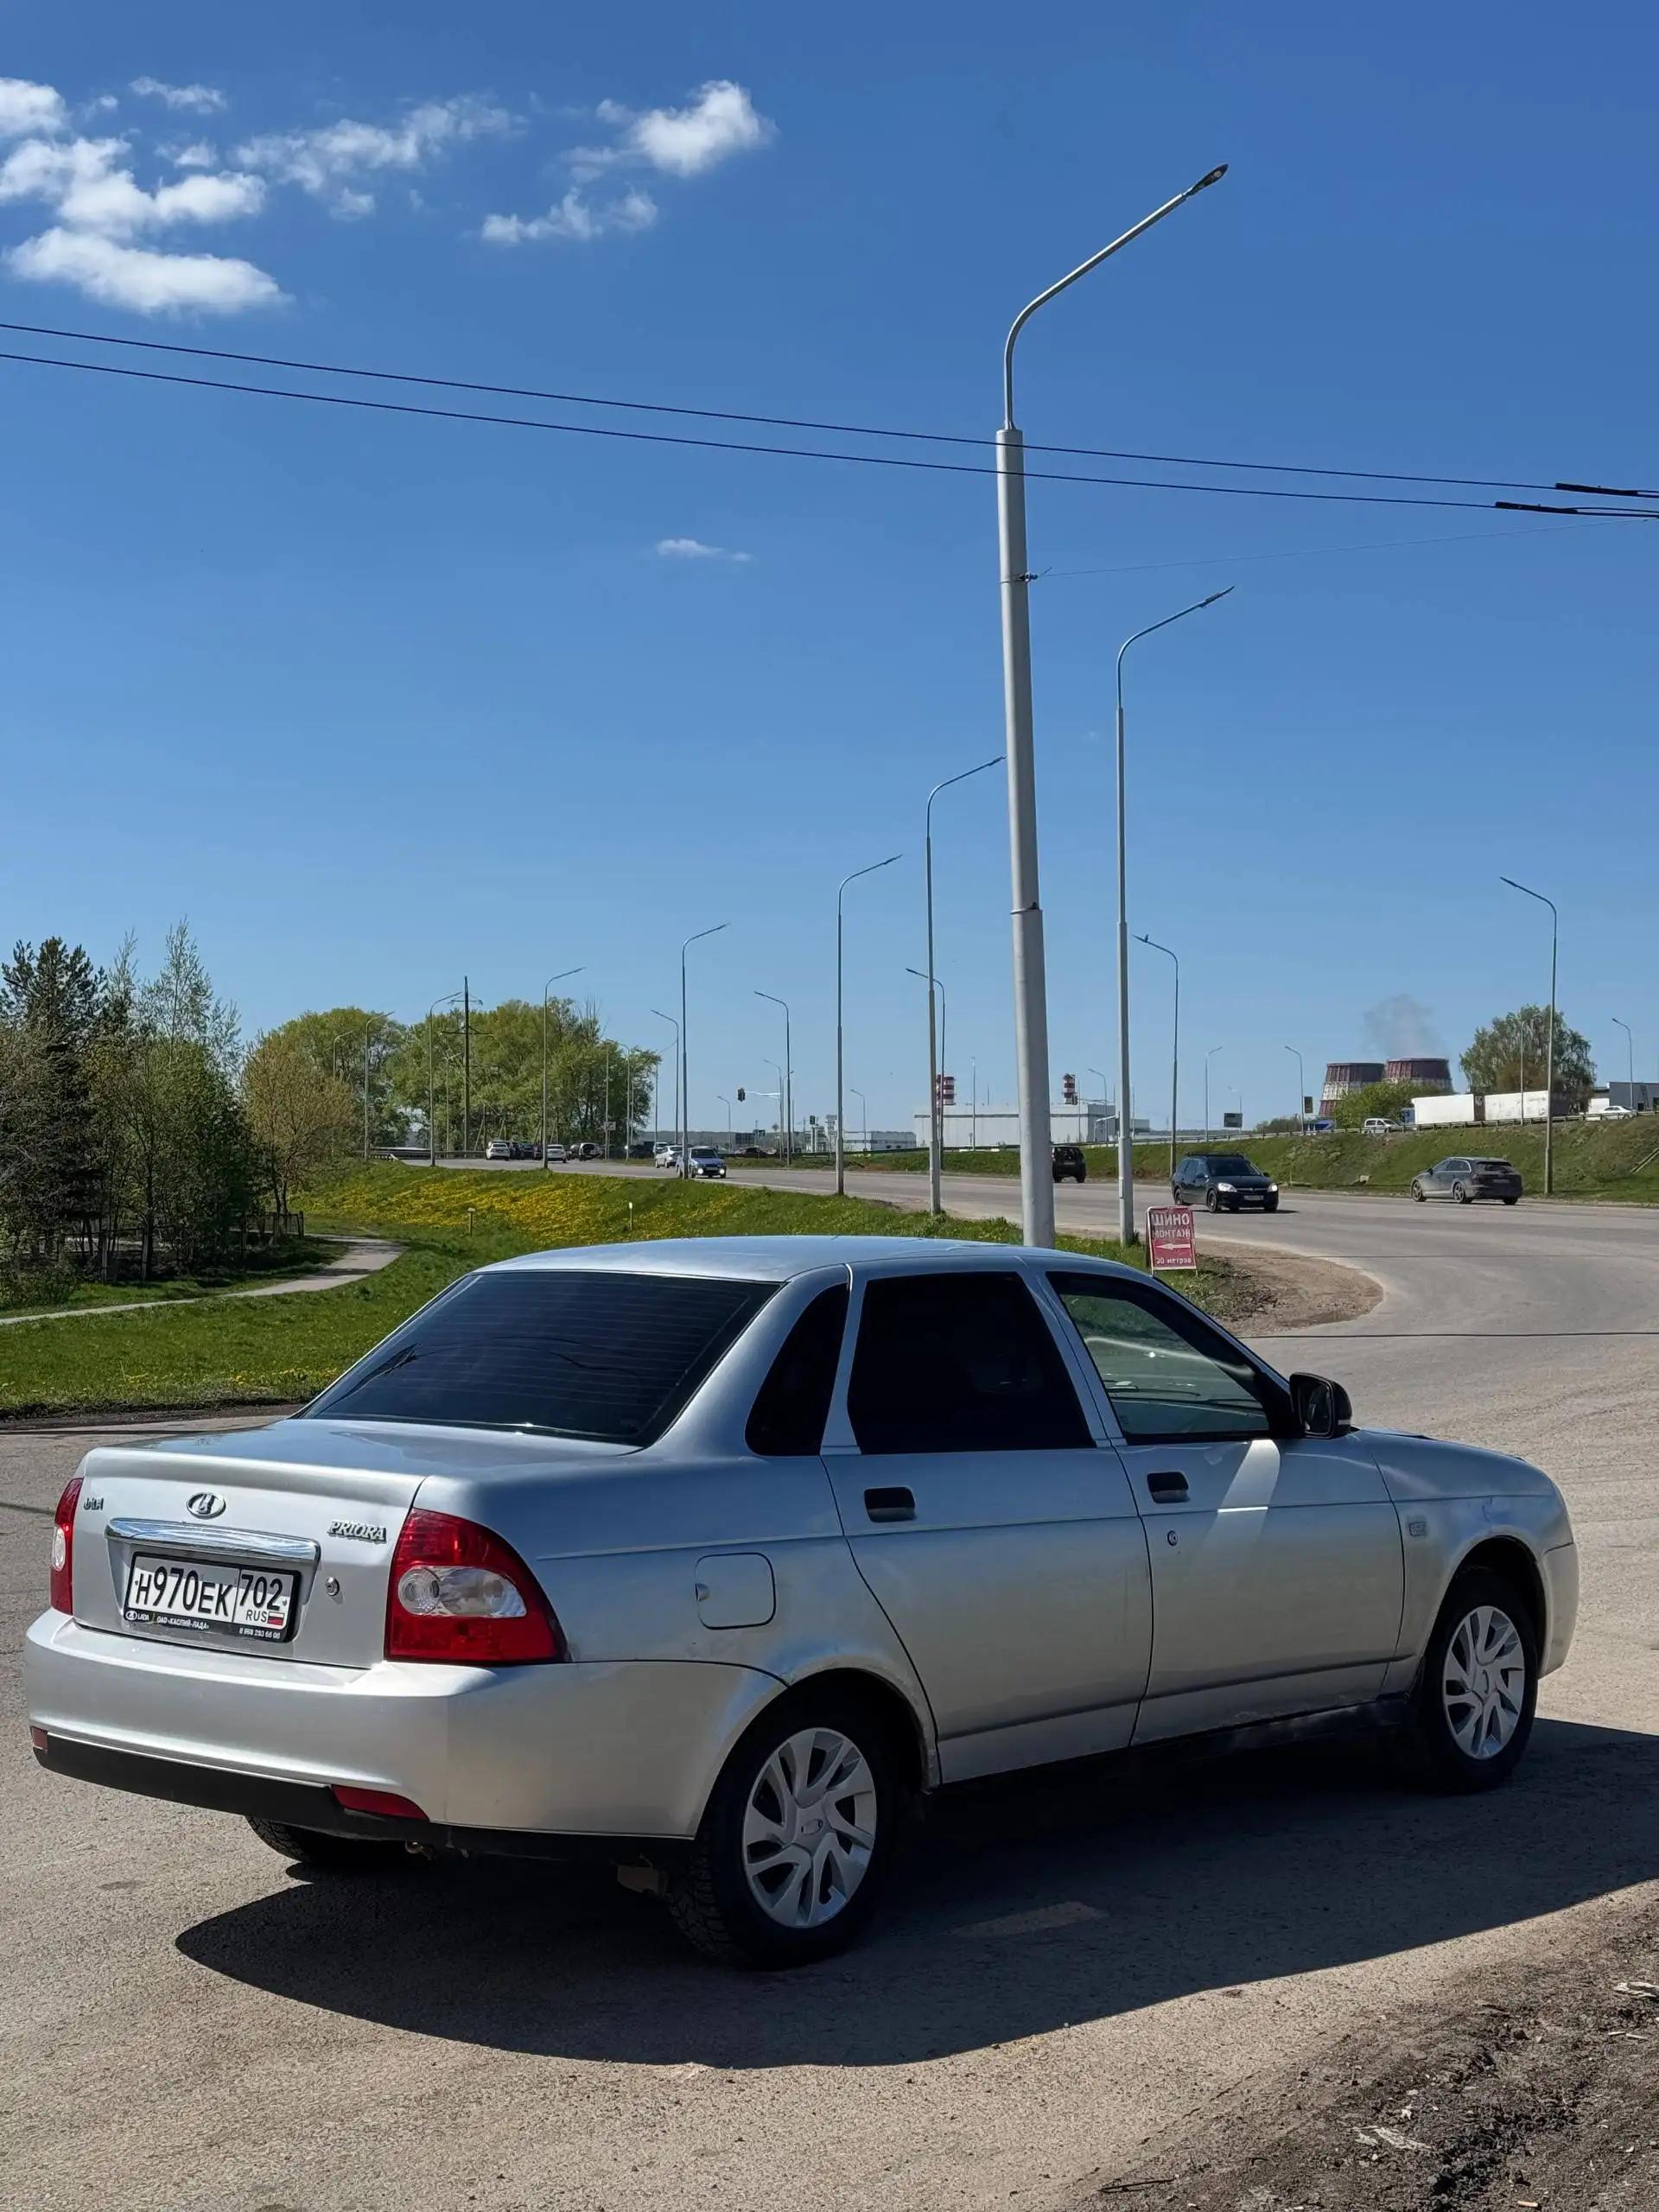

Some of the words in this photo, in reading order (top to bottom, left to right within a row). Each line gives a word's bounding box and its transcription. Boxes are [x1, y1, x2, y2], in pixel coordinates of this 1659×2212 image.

[1151, 1213, 1190, 1226] ШИНО
[1152, 1228, 1191, 1238] МОНТАЖ
[327, 1520, 387, 1543] PRIORA
[239, 1573, 283, 1611] 702
[246, 1610, 268, 1623] RUS
